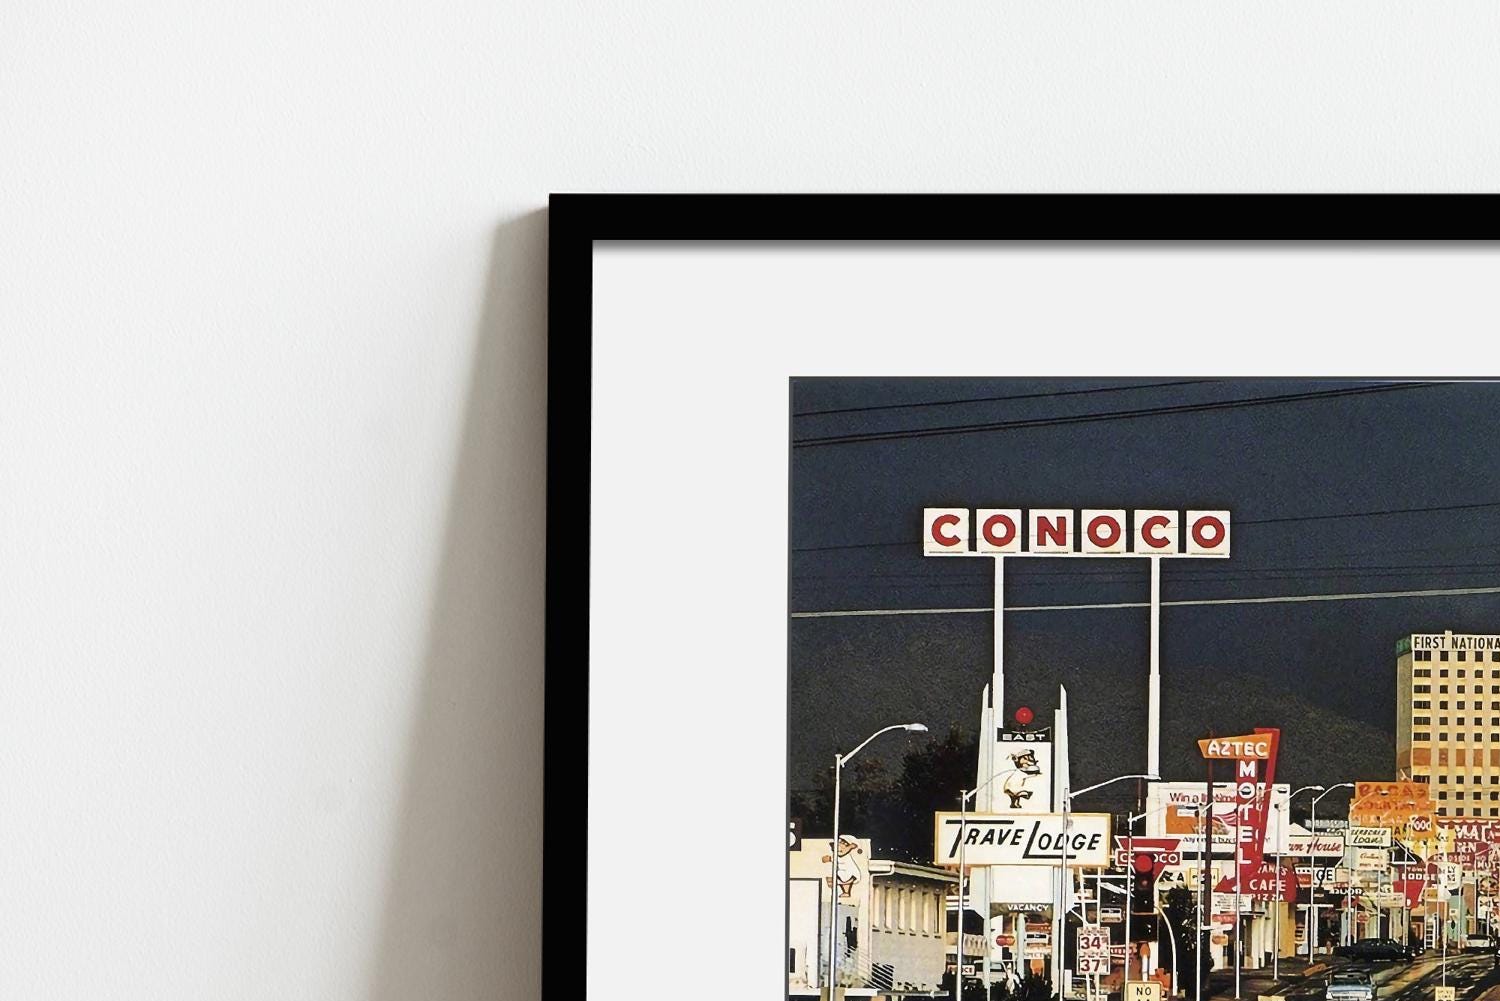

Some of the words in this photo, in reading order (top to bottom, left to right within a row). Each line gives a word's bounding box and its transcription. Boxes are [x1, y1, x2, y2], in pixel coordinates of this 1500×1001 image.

[931, 513, 1226, 549] CONOCO
[1414, 636, 1445, 649] FIRST
[1002, 733, 1046, 741] EAST
[1207, 739, 1269, 757] AZTEC
[1238, 760, 1257, 865] MOTEL
[1249, 879, 1287, 892] CAFE
[1251, 893, 1285, 901] PIZZA
[1007, 903, 1049, 912] VACANCY
[1080, 936, 1101, 950] 34
[1080, 959, 1101, 972] 37
[1136, 986, 1152, 996] NO
